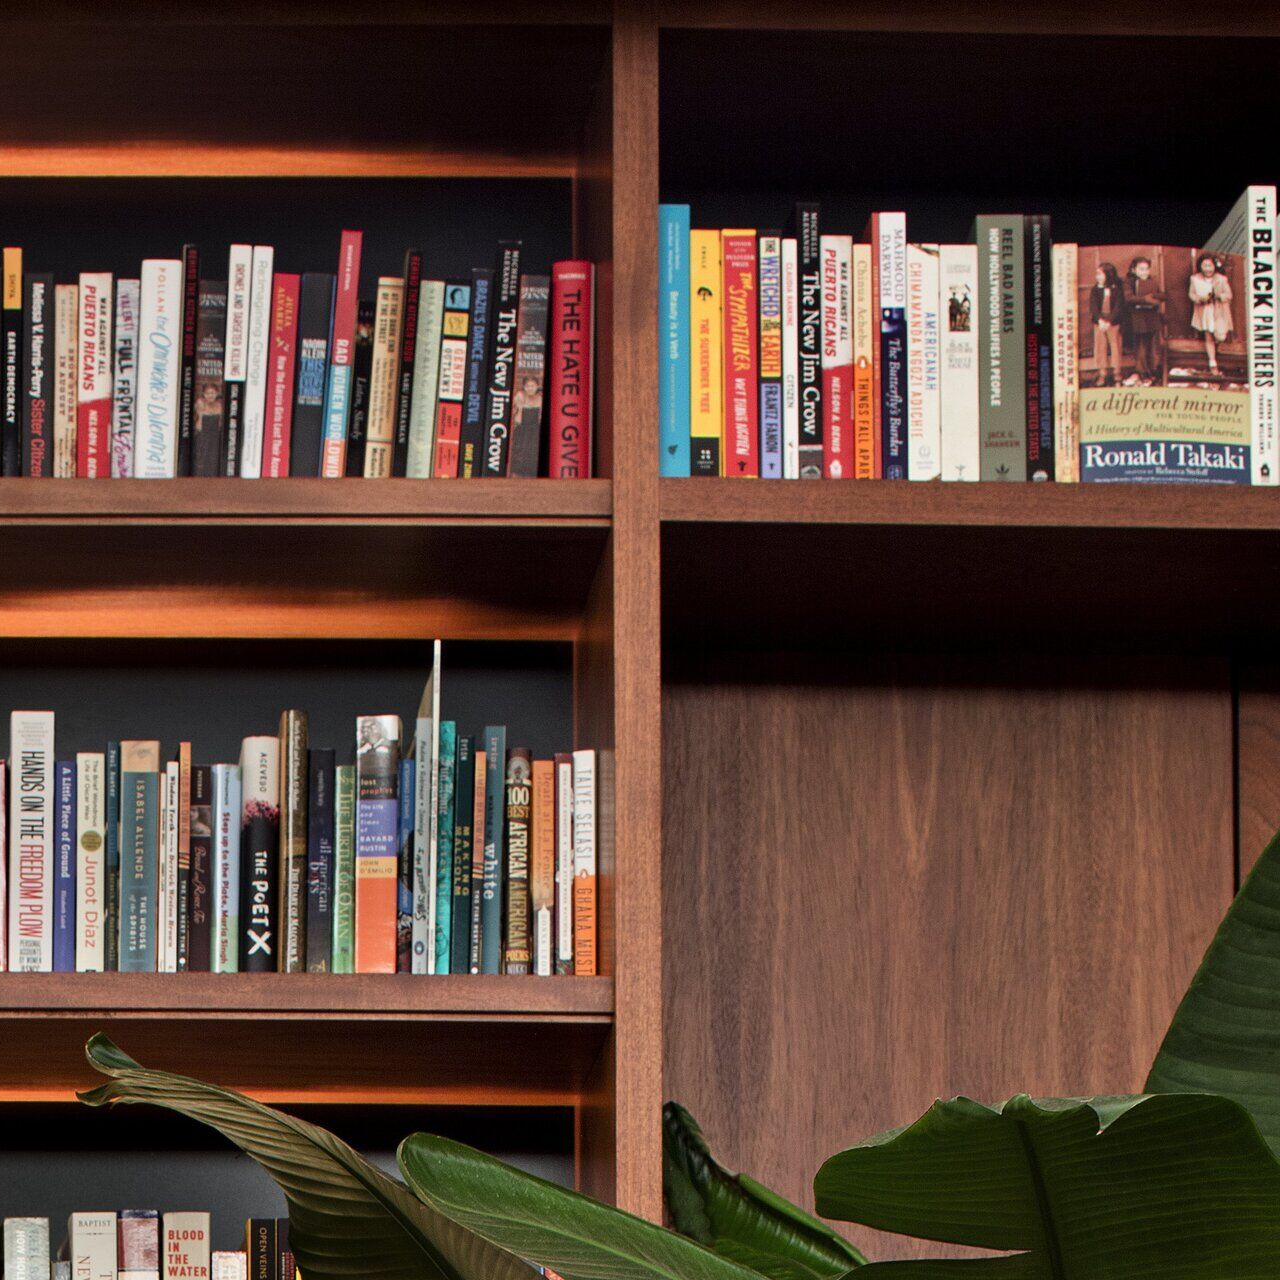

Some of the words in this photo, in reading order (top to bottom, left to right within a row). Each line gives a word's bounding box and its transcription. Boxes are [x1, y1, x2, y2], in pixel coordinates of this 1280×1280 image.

[1256, 198, 1266, 222] THE
[1253, 229, 1272, 308] BLACK
[803, 272, 819, 306] The
[562, 289, 581, 332] THE
[803, 310, 819, 350] New
[561, 340, 580, 395] HATE
[800, 353, 821, 384] Jim
[924, 312, 936, 391] AMERICANAH
[1254, 316, 1273, 387] PANTHERS
[561, 403, 579, 417] U
[804, 388, 820, 435] Crow
[1086, 401, 1097, 411] a
[1102, 393, 1176, 414] different
[1184, 395, 1243, 414] mirror
[561, 425, 579, 478] GIVE
[1085, 443, 1165, 467] Ronald
[1170, 444, 1245, 469] Takaki
[21, 751, 44, 791] HANDS
[21, 796, 44, 811] ON
[136, 780, 144, 821] ISABEL
[21, 818, 43, 840] THE
[135, 826, 144, 879] ALLENDE
[256, 851, 267, 875] THE
[20, 845, 43, 899] FREEDOM
[85, 856, 98, 904] Junot
[484, 844, 497, 900] white
[19, 904, 43, 937] PLOW
[248, 929, 271, 955] X
[168, 1230, 203, 1240] BLOOD
[168, 1242, 179, 1252] IN
[168, 1255, 189, 1264] THE
[168, 1266, 207, 1277] WATER
